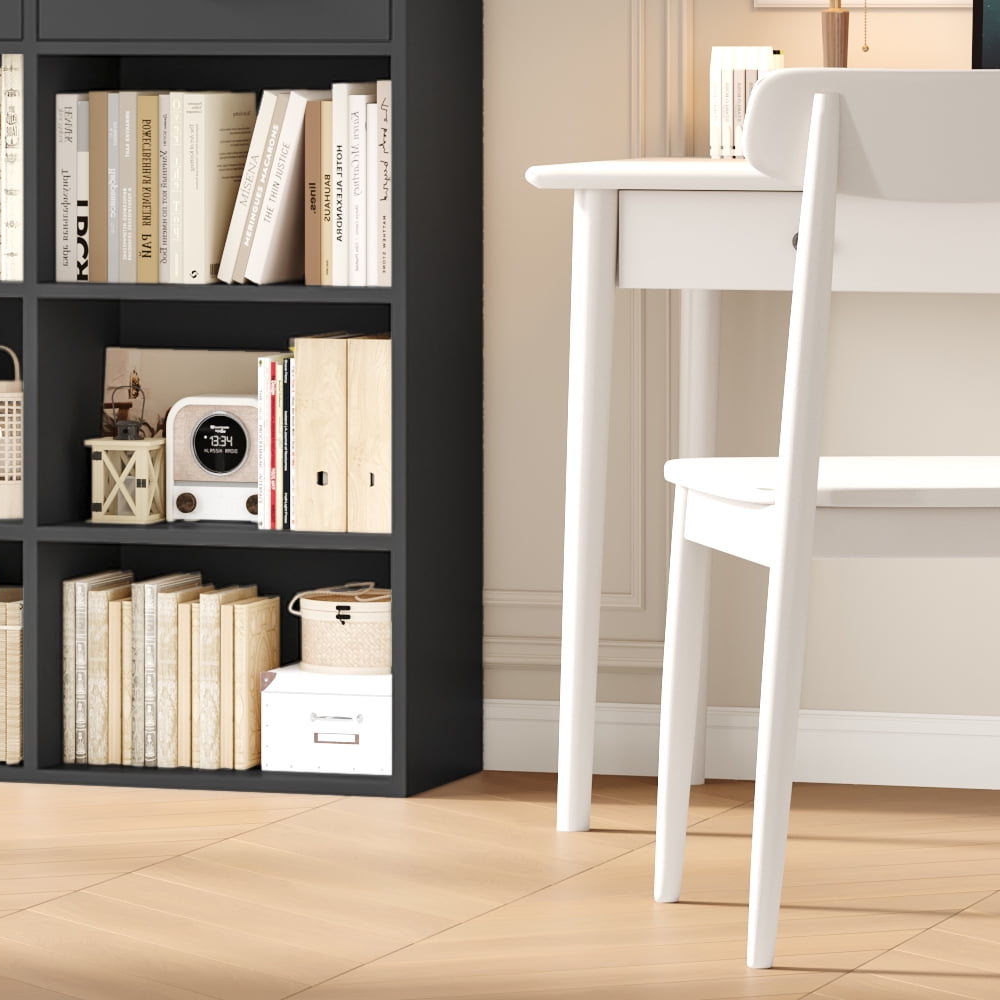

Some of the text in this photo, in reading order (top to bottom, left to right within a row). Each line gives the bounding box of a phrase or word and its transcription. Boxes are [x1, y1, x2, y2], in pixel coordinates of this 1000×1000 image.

[244, 124, 279, 247] MERINGUES MACARONS
[263, 142, 290, 223] THE THIN JUSTICE
